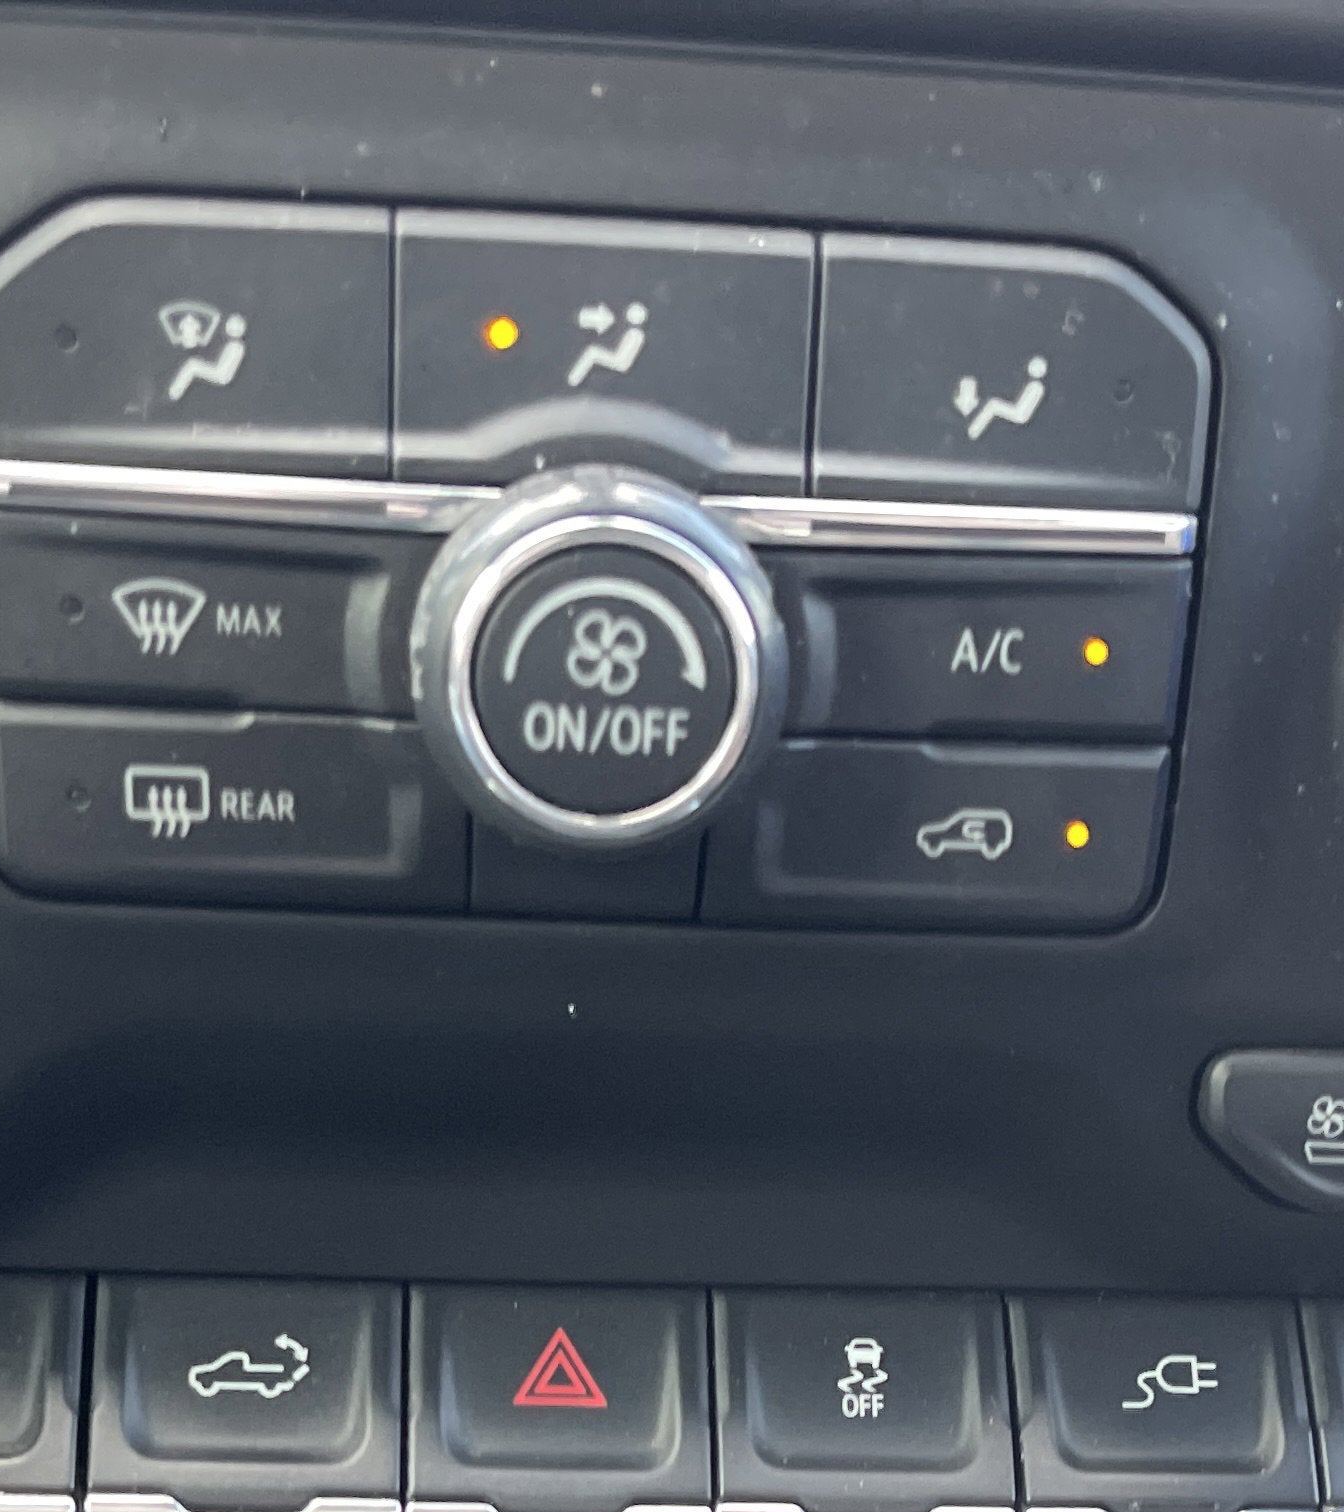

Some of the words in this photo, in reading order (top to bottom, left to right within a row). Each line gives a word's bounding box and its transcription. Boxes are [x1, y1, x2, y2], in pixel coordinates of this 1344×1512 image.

[215, 602, 283, 637] MAX
[949, 627, 1025, 675] A/C
[522, 702, 690, 758] ON/OFF
[220, 788, 296, 821] REAR
[840, 1391, 886, 1420] OFF
